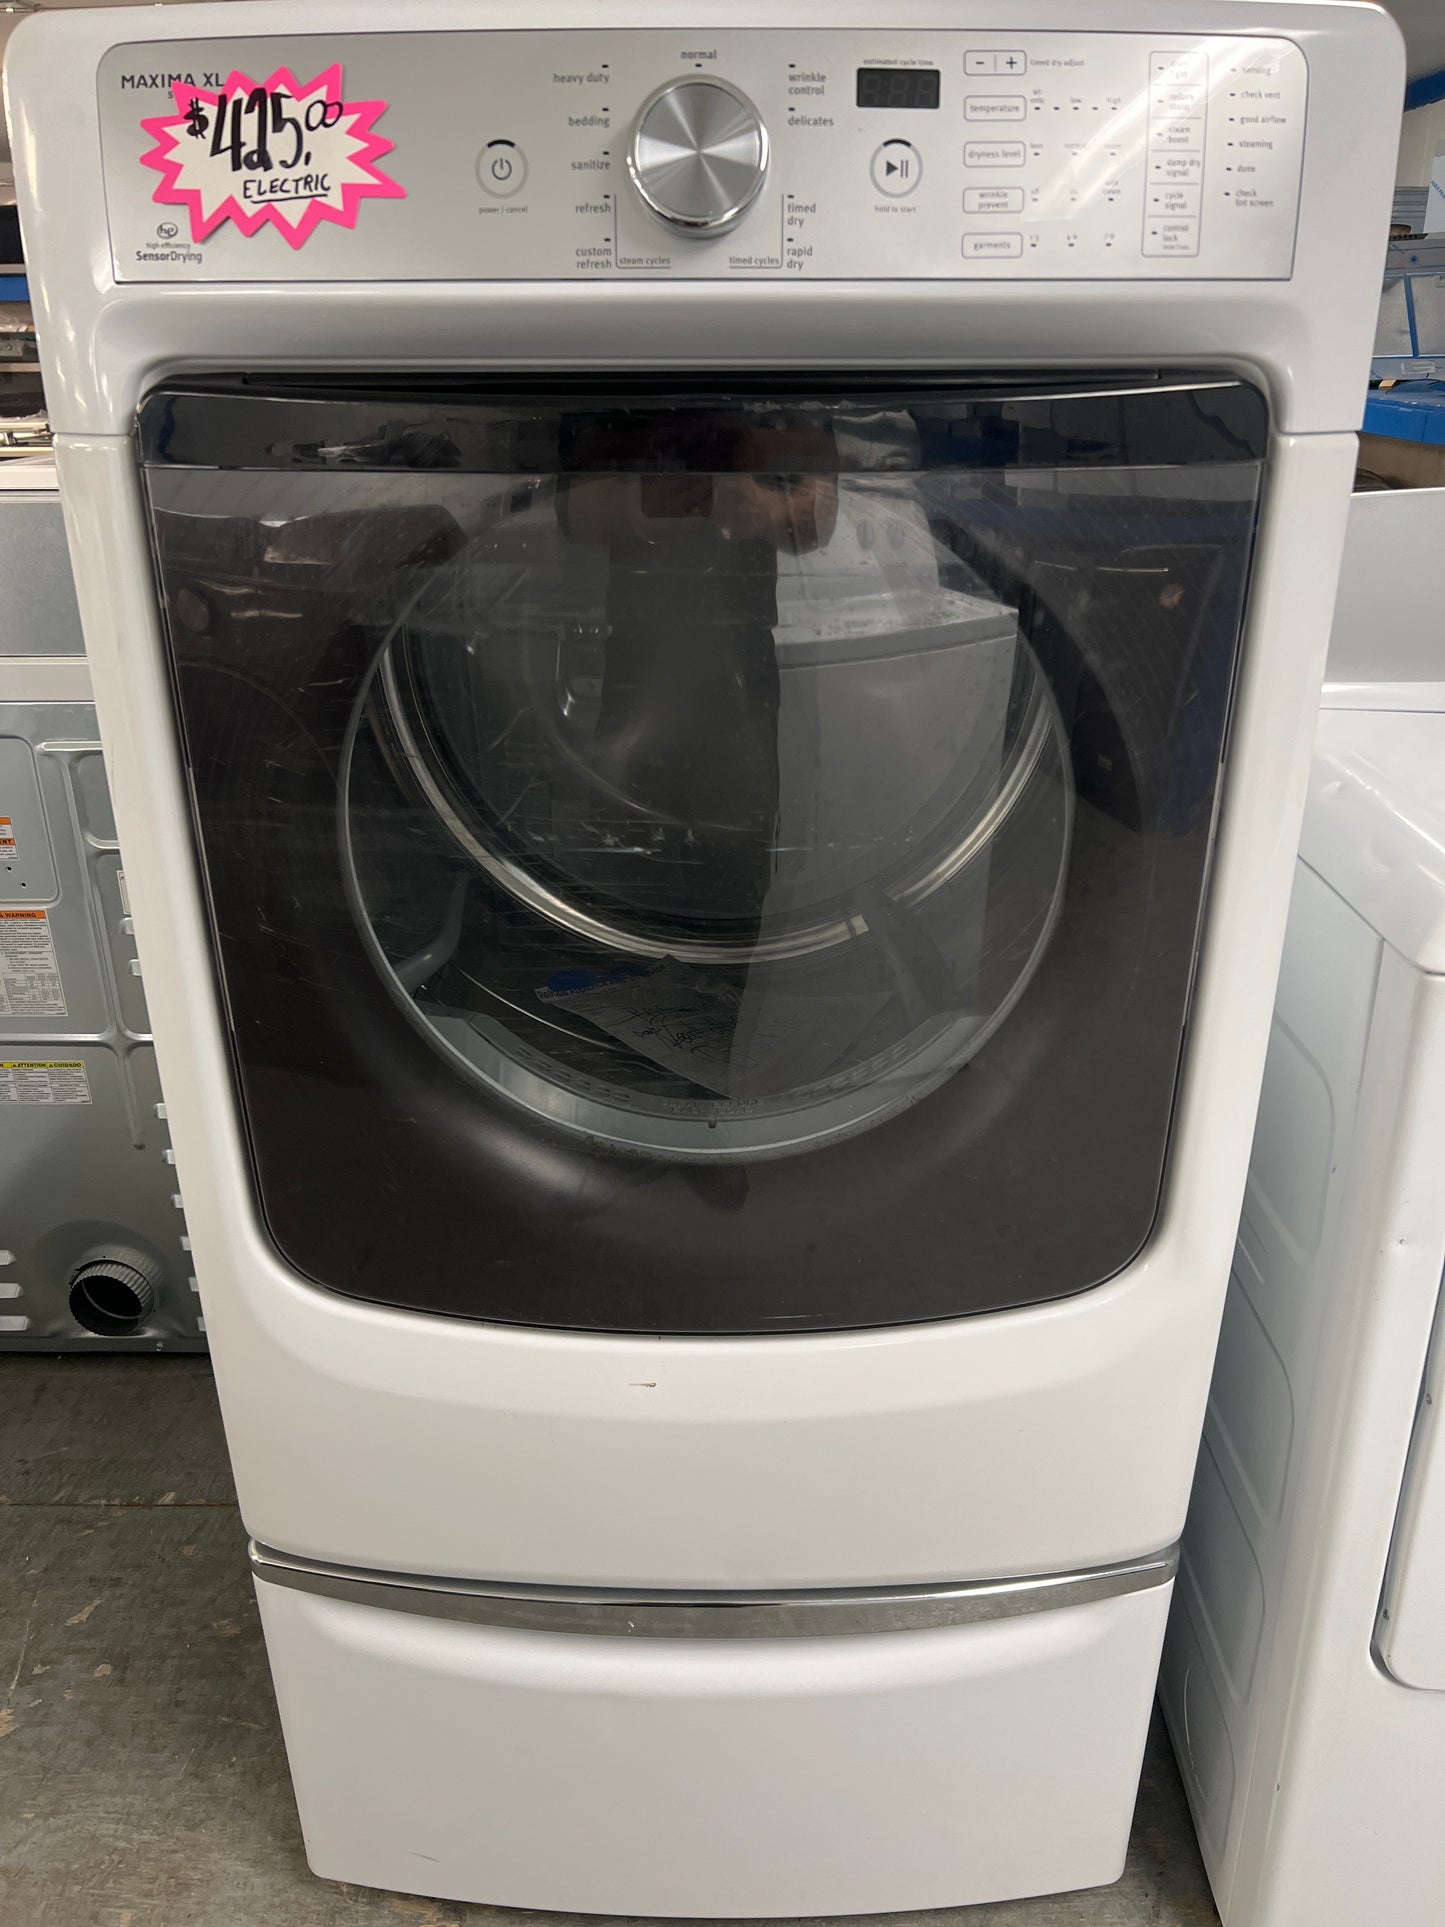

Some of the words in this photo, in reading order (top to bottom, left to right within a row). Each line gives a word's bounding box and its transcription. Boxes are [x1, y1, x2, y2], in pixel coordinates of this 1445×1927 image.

[681, 50, 717, 60] normal
[1051, 59, 1062, 68] dry
[1063, 59, 1085, 68] adjust
[121, 73, 196, 89] MAXIMA
[203, 73, 225, 87] XL
[553, 73, 584, 85] heavy
[587, 73, 610, 84] duty
[788, 73, 827, 82] wrinkle
[788, 86, 825, 96] control
[970, 104, 1020, 113] temperature
[568, 116, 610, 128] bedding
[788, 116, 834, 126] delicates
[1240, 116, 1259, 125] good
[1239, 139, 1273, 150] steaming
[968, 149, 1000, 159] dryness
[571, 158, 611, 171] sanitize
[1189, 159, 1200, 167] dry
[243, 173, 331, 199] ELECTRIC
[575, 202, 611, 214] refresh
[787, 202, 817, 213] timed
[978, 200, 1008, 209] prevent
[478, 206, 499, 215] power
[506, 205, 528, 213] cancel
[787, 215, 804, 227] dry
[973, 241, 1012, 251] garments
[135, 250, 203, 264] SensorDrying
[575, 247, 612, 257] custom
[786, 246, 813, 259] rapid
[576, 260, 612, 270] refresh
[645, 257, 671, 268] cycles
[729, 257, 753, 265] timed
[754, 256, 780, 268] cycles
[786, 260, 804, 272] dry
